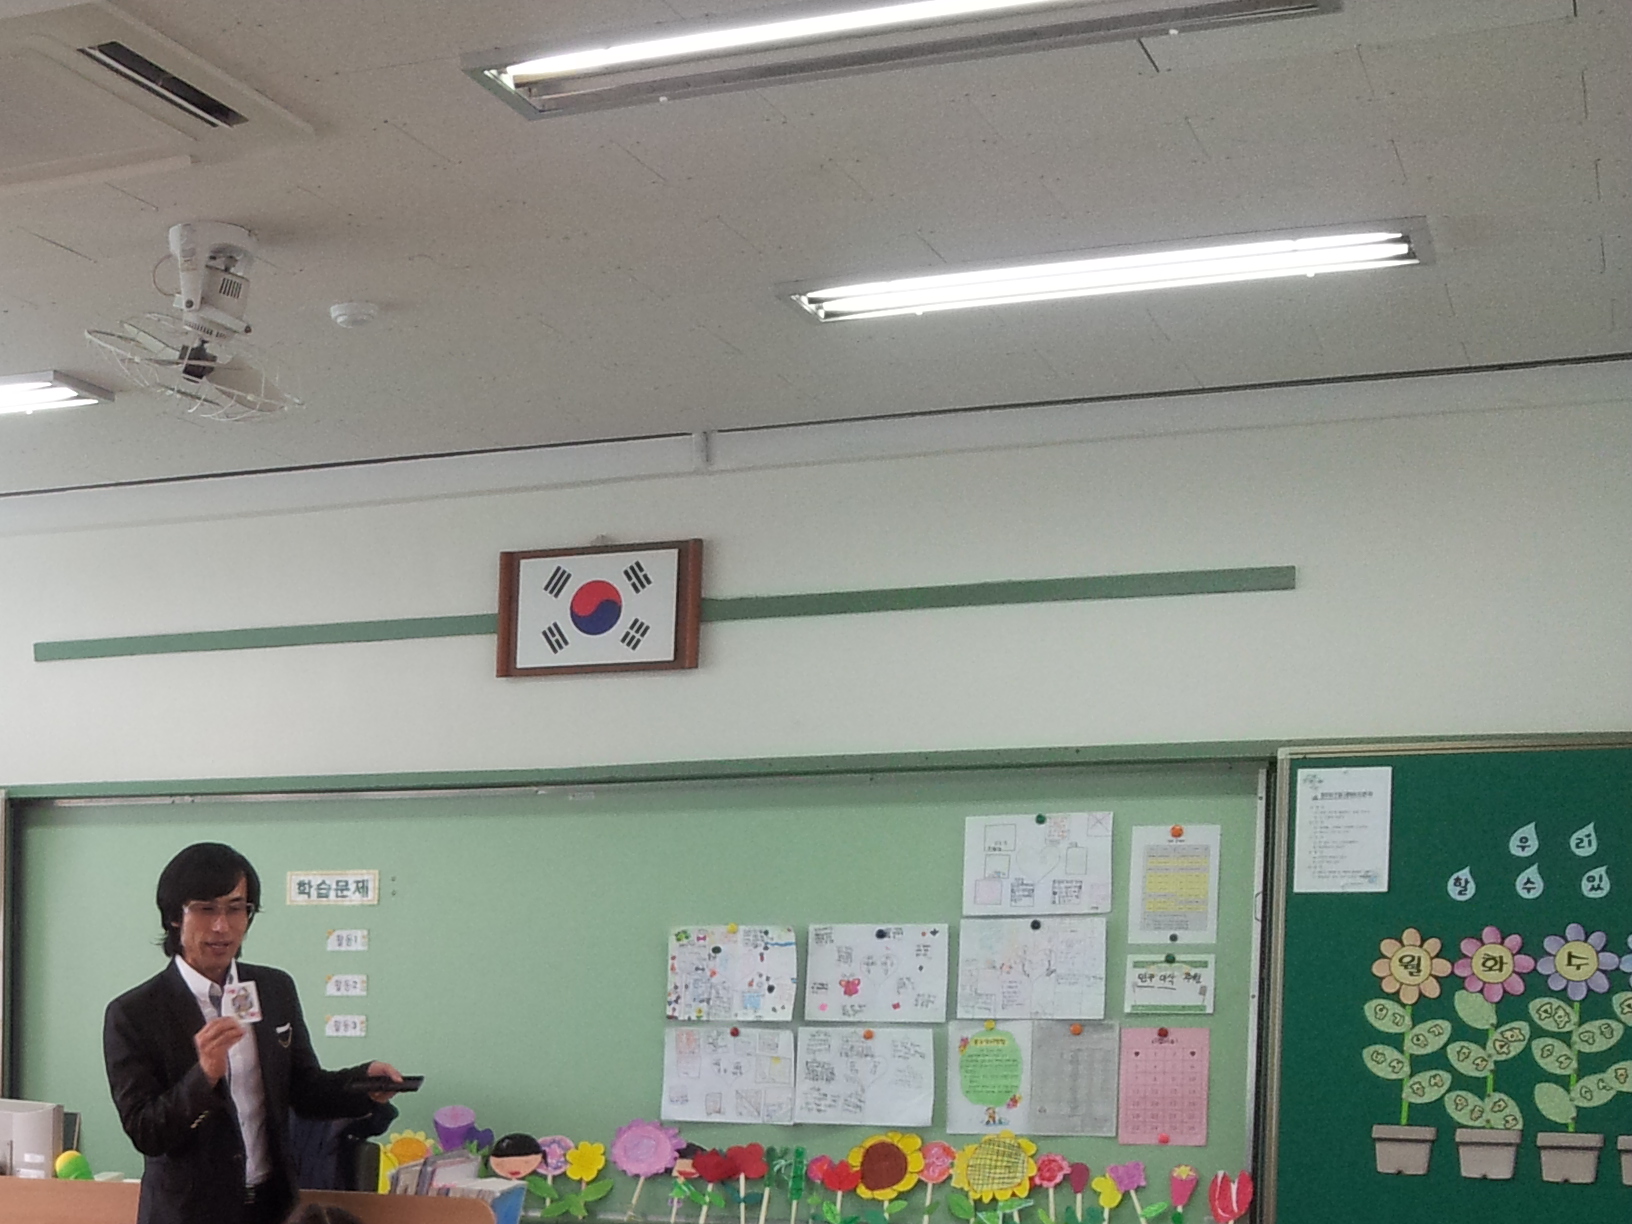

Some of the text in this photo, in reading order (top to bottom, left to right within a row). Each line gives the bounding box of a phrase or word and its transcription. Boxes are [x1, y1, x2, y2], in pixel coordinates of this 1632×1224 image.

[297, 879, 370, 899] 학습문제
[1521, 877, 1536, 894] 수
[1398, 954, 1422, 977] 월
[1481, 953, 1508, 973] 화
